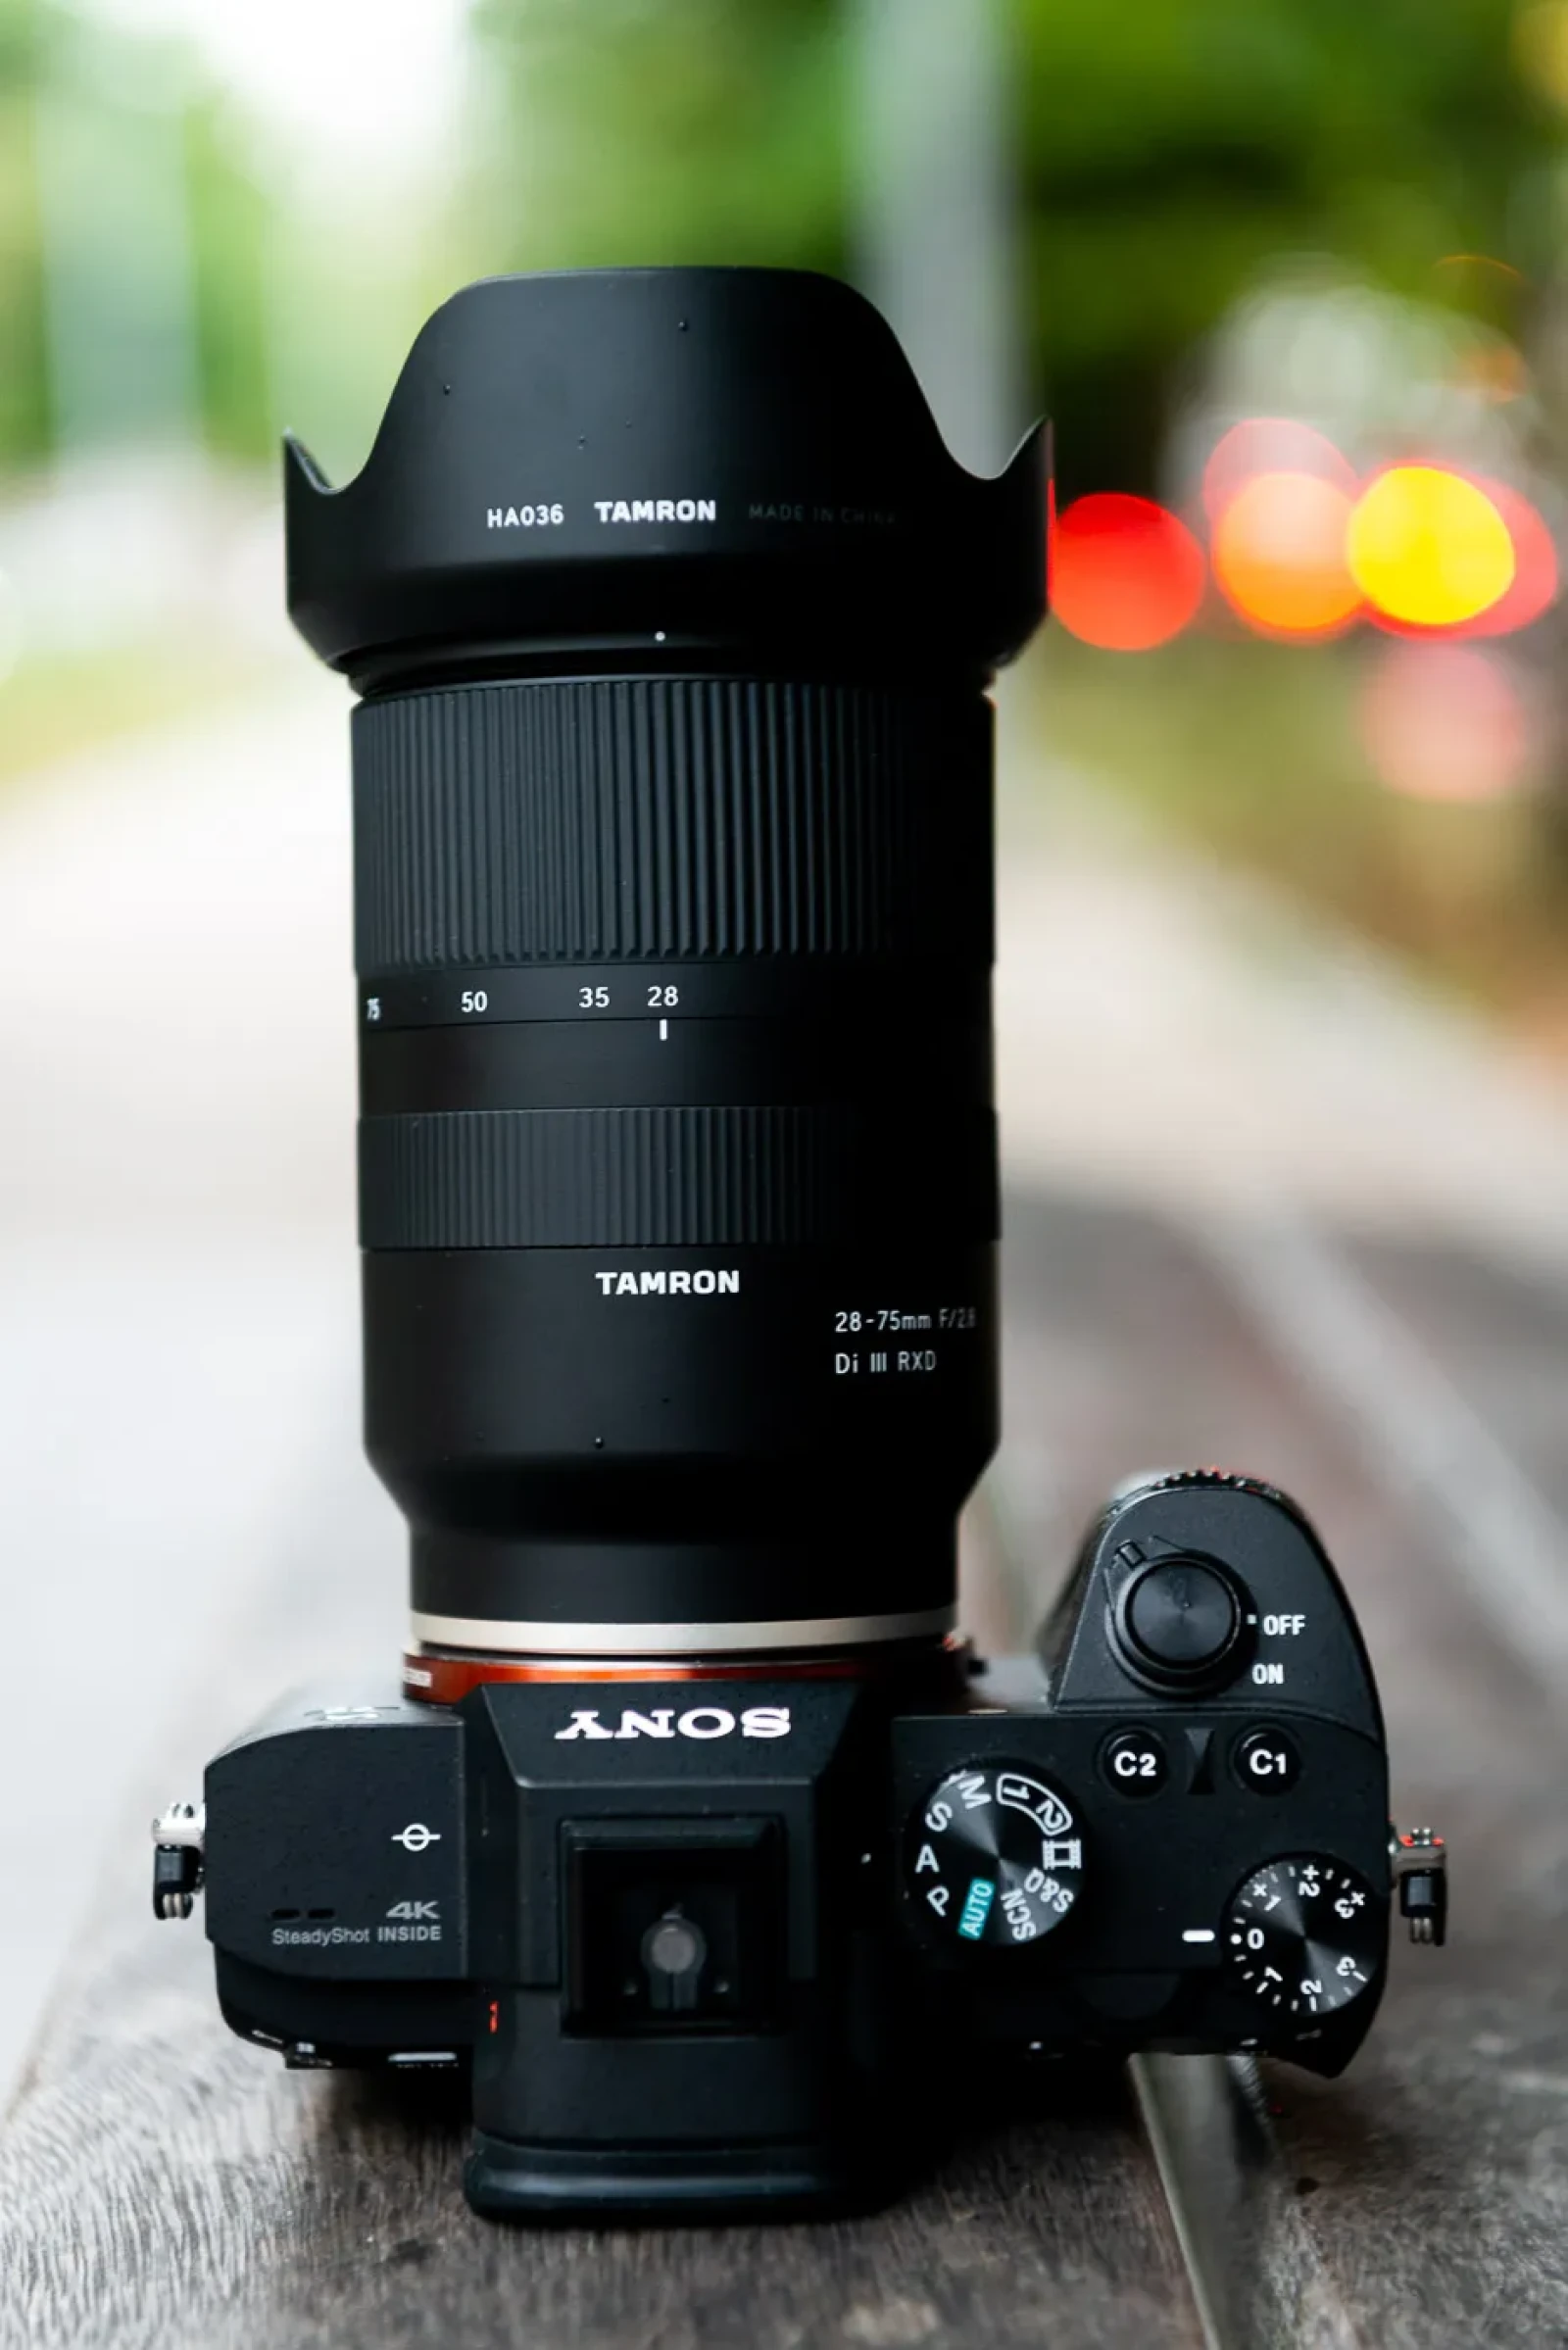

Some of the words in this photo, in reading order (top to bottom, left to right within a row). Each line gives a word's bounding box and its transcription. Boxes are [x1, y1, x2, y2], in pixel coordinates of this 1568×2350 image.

[487, 503, 564, 528] HA036
[593, 499, 716, 523] TAMRON
[748, 503, 805, 520] MADE
[461, 991, 488, 1013] 50
[578, 986, 611, 1008] 35
[647, 986, 679, 1007] 28
[595, 1270, 740, 1296] TAMRON
[835, 1309, 931, 1333] 28-75mm
[835, 1351, 859, 1374] Di
[869, 1351, 888, 1373] III
[897, 1349, 937, 1372] RXD
[1263, 1614, 1305, 1636] OFF
[1252, 1663, 1285, 1685] ON
[555, 1706, 792, 1739] SONY
[1113, 1750, 1157, 1777] C2
[1250, 1749, 1287, 1775] C1
[957, 1775, 992, 1810] M
[924, 1801, 953, 1832] S
[914, 1843, 941, 1873] A
[386, 1900, 440, 1920] 4K
[926, 1885, 950, 1917] P
[960, 1881, 994, 1937] AUTO
[1001, 1887, 1037, 1940] SCN
[271, 1926, 370, 1946] SteadyShot
[378, 1925, 442, 1942] INSIDE
[1247, 1928, 1265, 1950] 0
